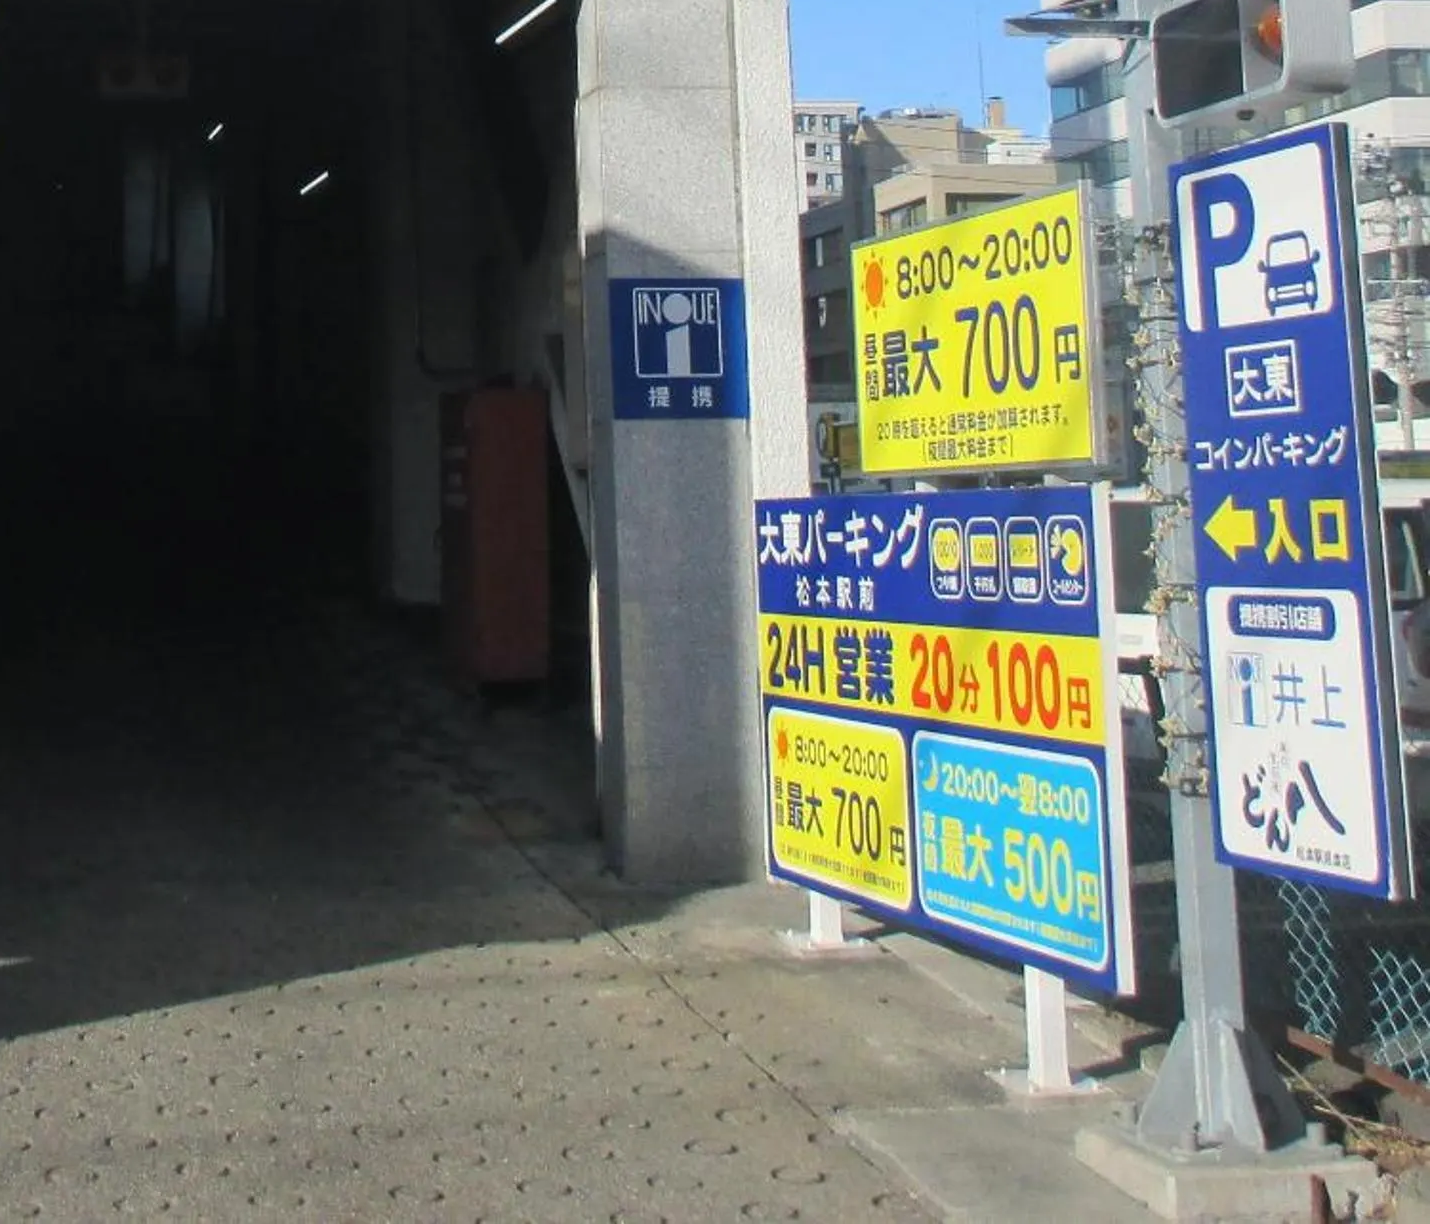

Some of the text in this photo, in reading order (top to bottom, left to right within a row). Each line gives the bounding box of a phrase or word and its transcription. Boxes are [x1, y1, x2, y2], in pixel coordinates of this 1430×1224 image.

[1192, 173, 1256, 331] P
[1233, 354, 1295, 404] 大東
[1195, 425, 1348, 471] コインパーキング
[759, 503, 924, 569] 大東パーキング
[1264, 497, 1350, 563] 入口
[796, 573, 874, 612] 松本駅前
[1272, 662, 1346, 729] 井上
